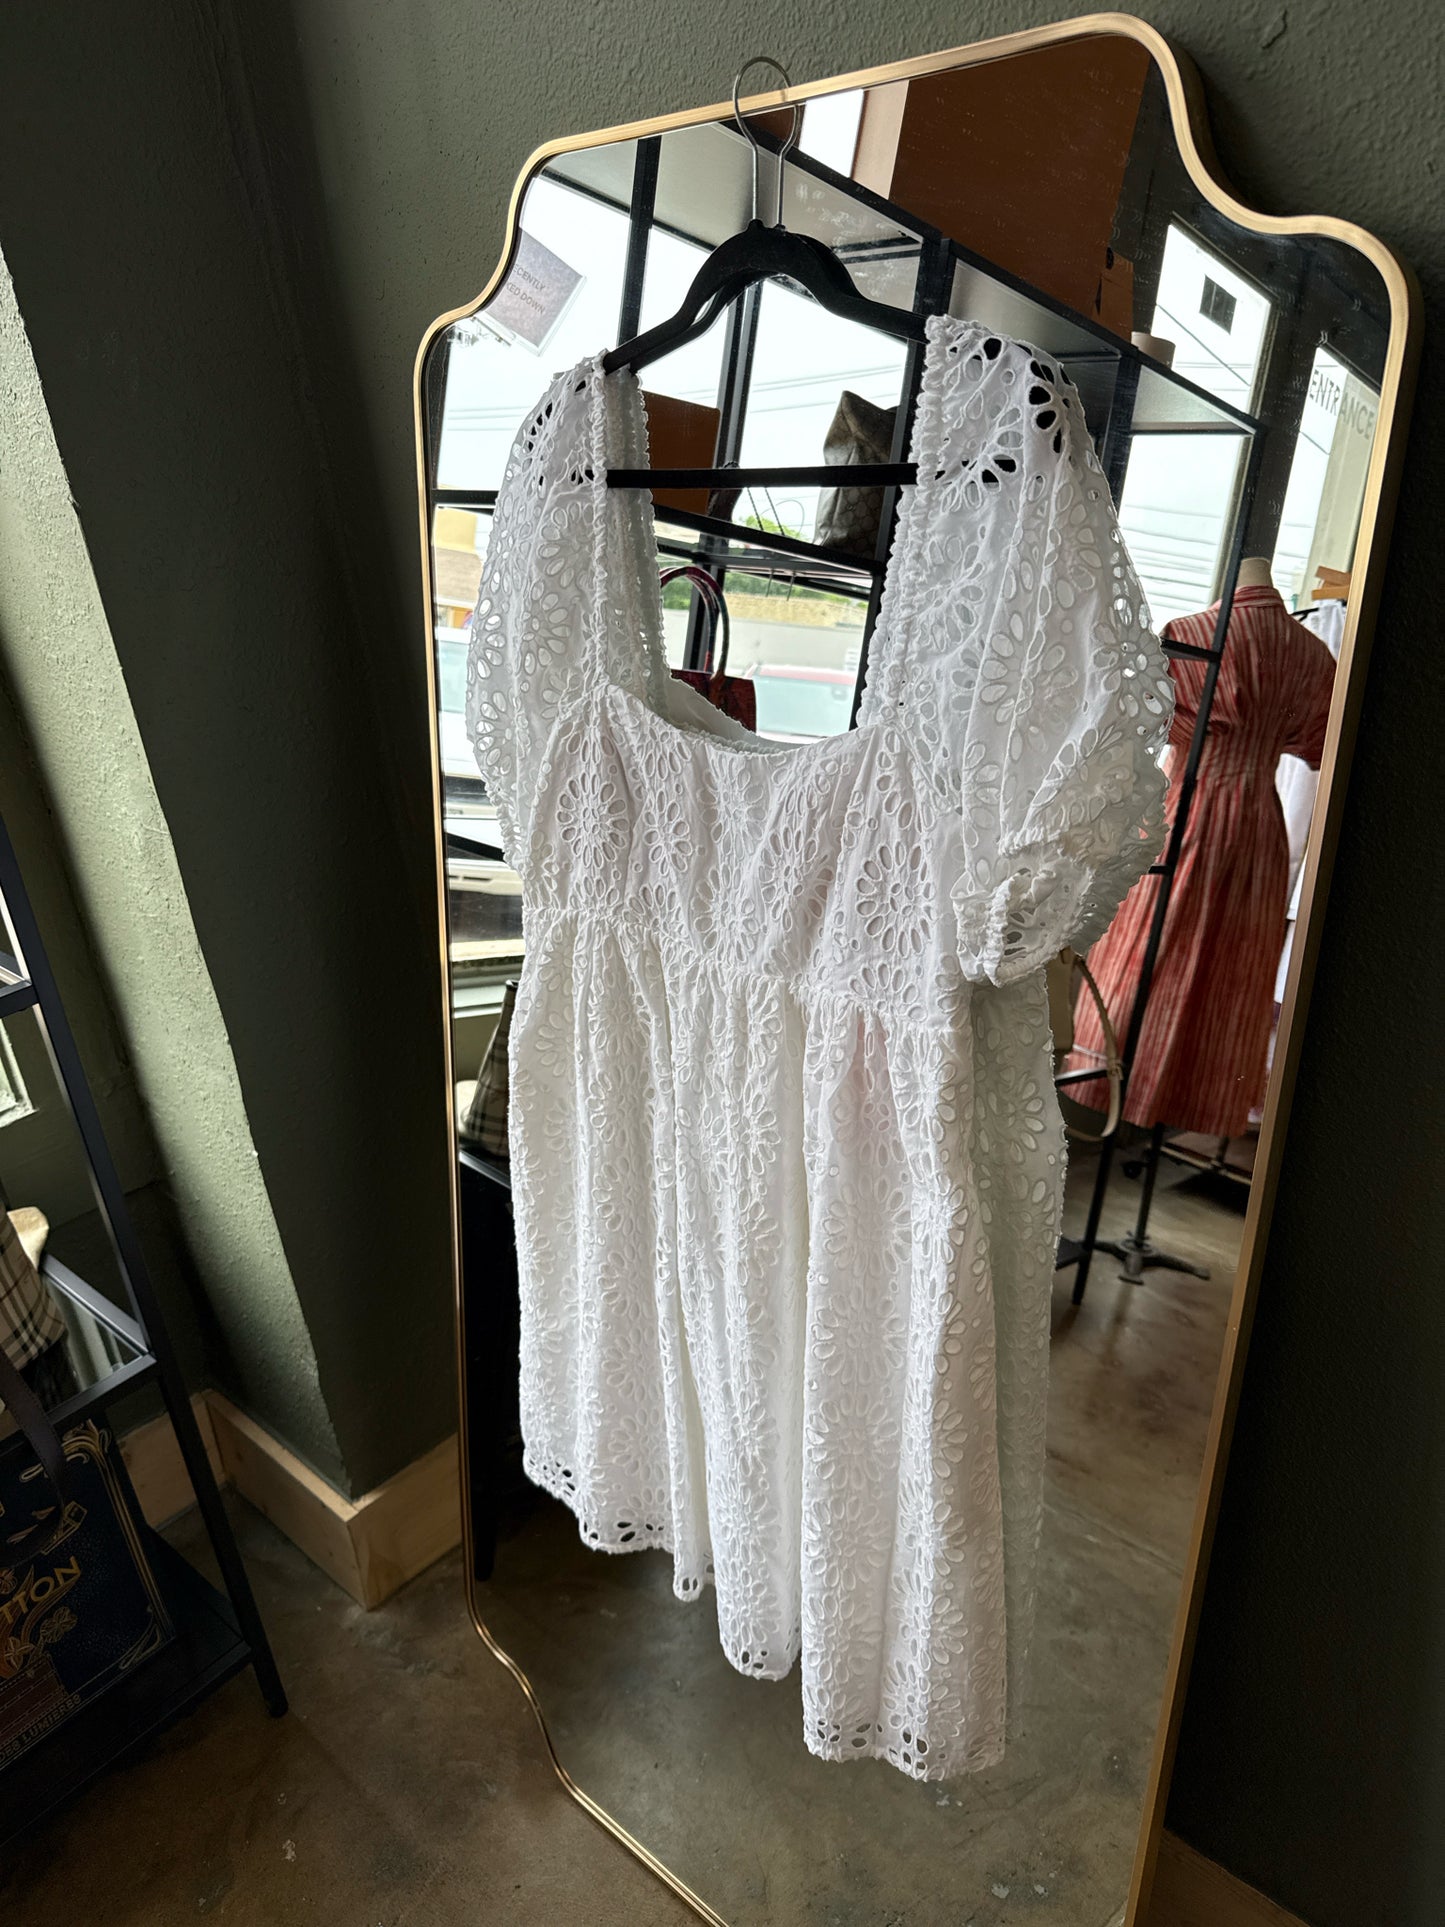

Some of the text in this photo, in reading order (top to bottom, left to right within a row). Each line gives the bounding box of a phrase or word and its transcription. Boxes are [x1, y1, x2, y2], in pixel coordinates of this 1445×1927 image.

[520, 292, 545, 314] DOWN
[1309, 369, 1375, 440] ENTRANCE
[0, 1555, 81, 1625] TTON
